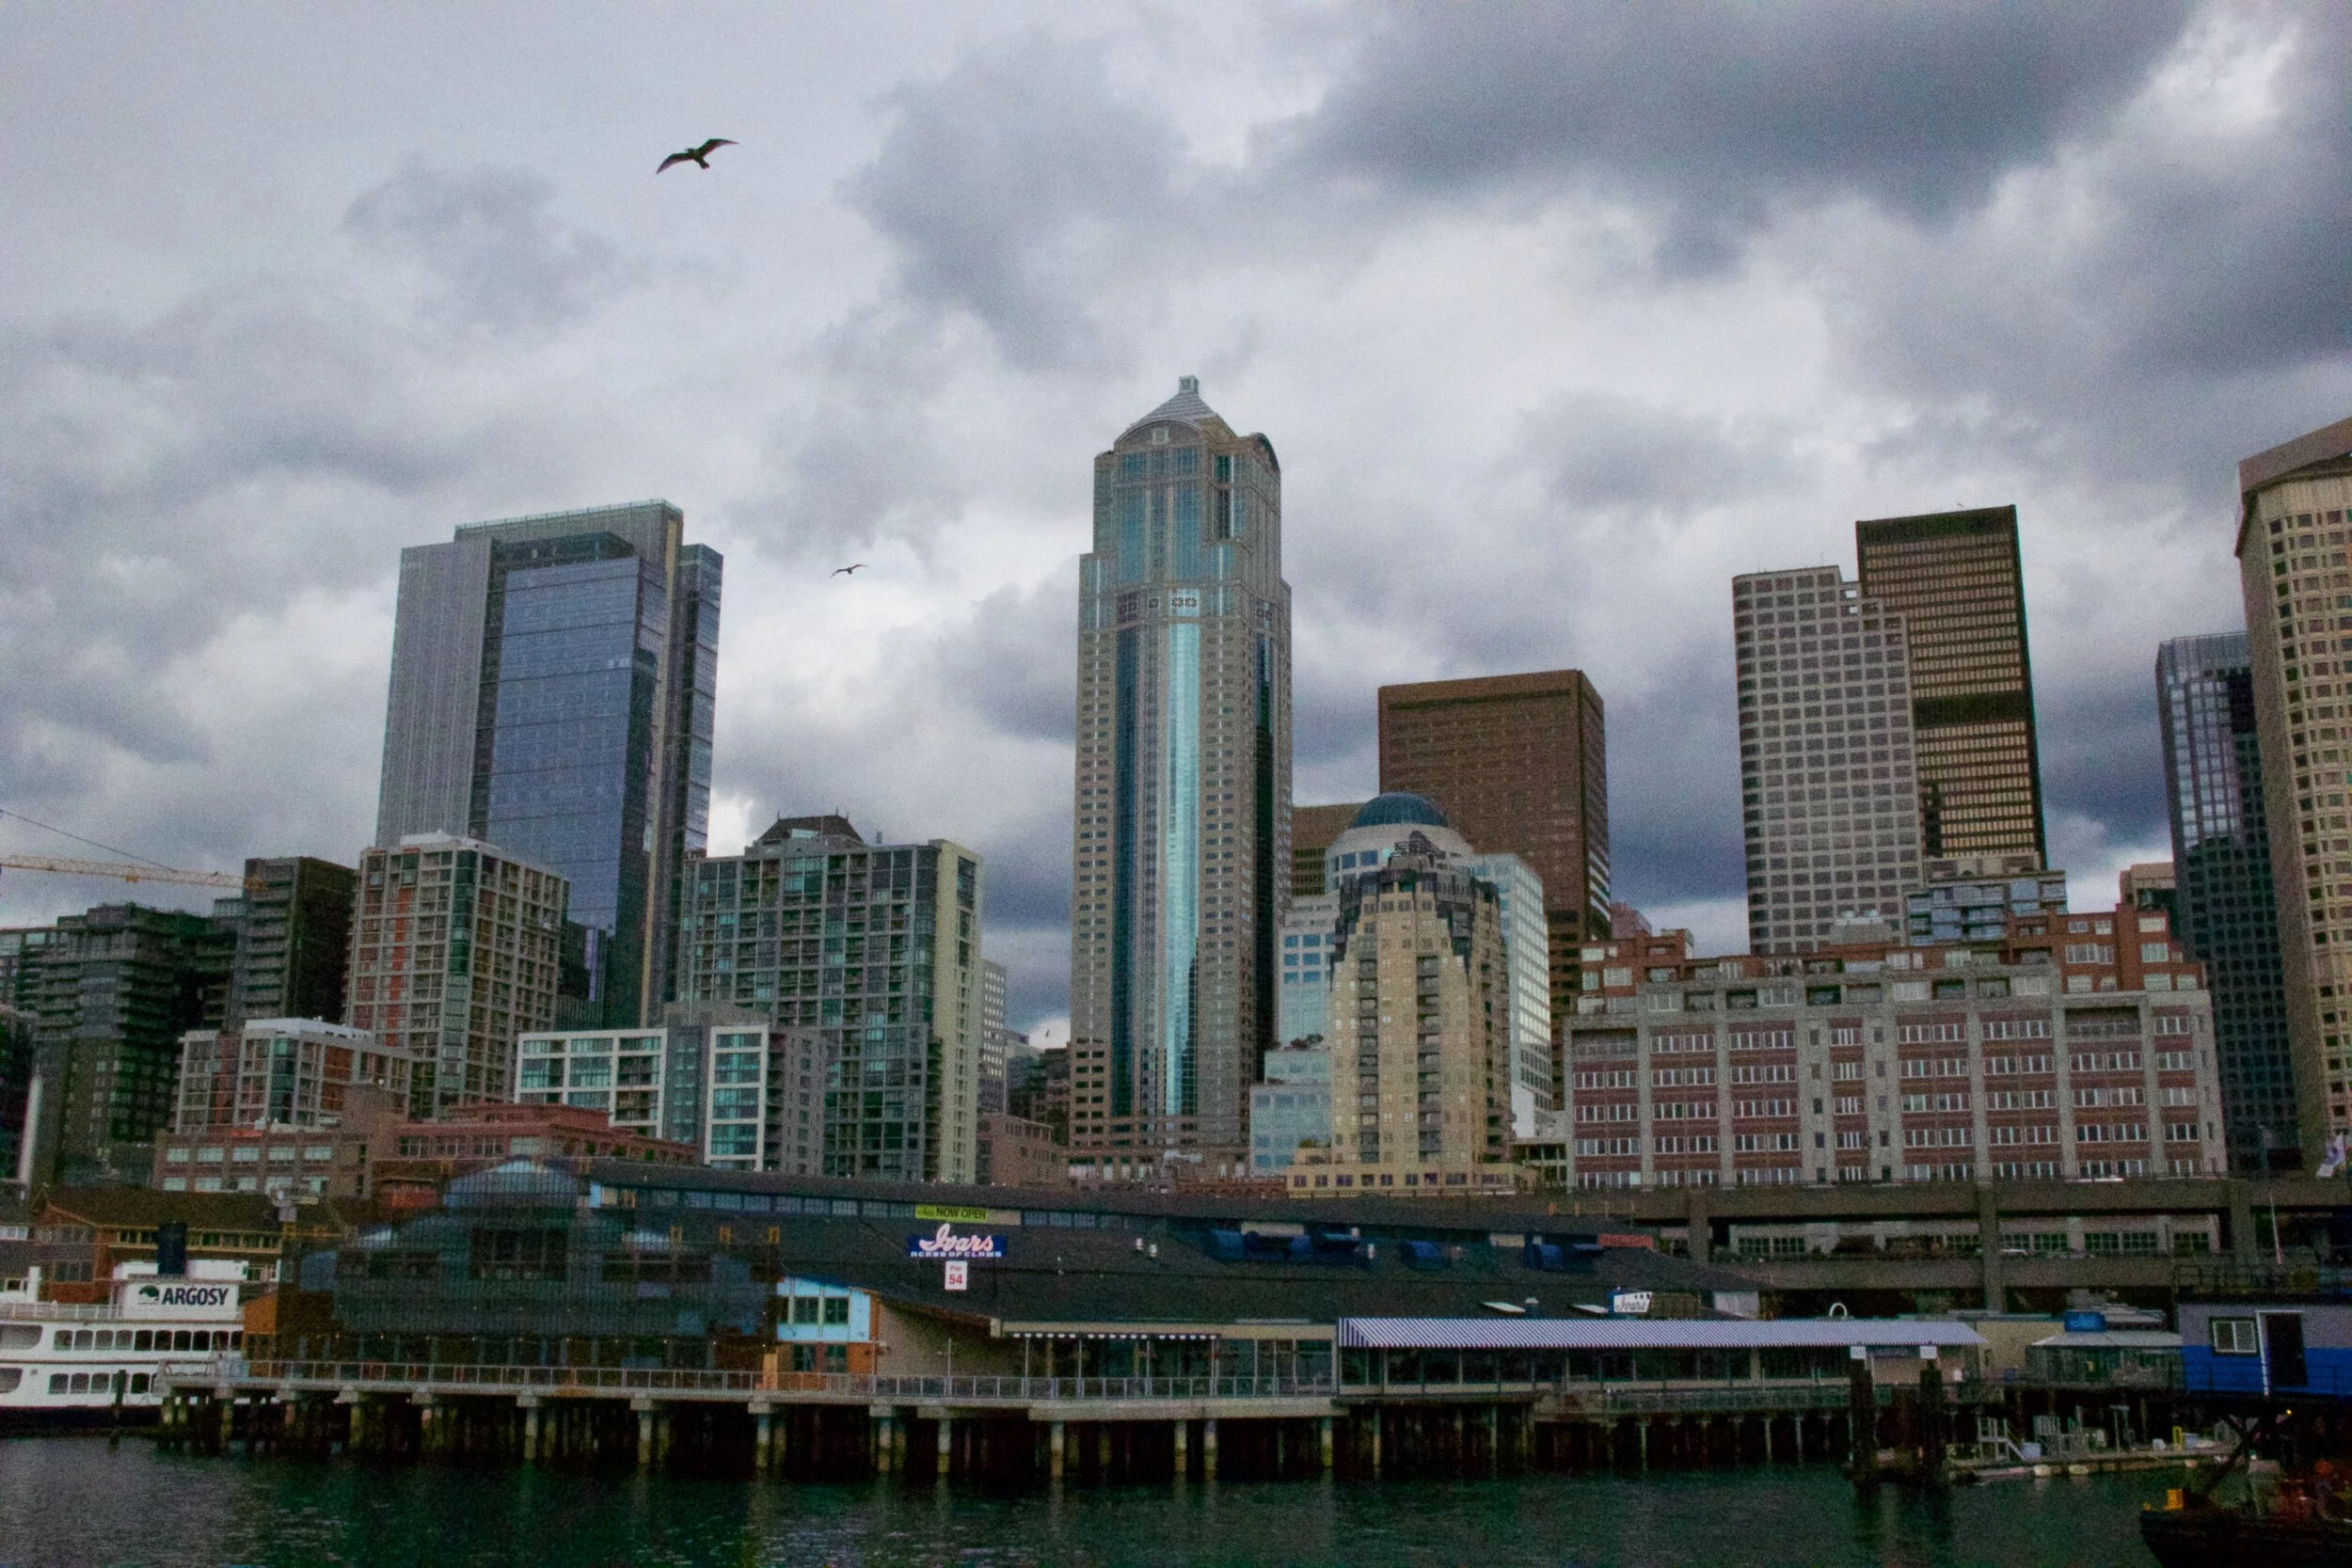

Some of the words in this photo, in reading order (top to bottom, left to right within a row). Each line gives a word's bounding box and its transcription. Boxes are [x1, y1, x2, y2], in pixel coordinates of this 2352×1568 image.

[936, 1207, 960, 1218] NOW
[961, 1208, 986, 1219] OPEN
[948, 1274, 963, 1285] 54
[161, 1287, 230, 1306] ARGOSY
